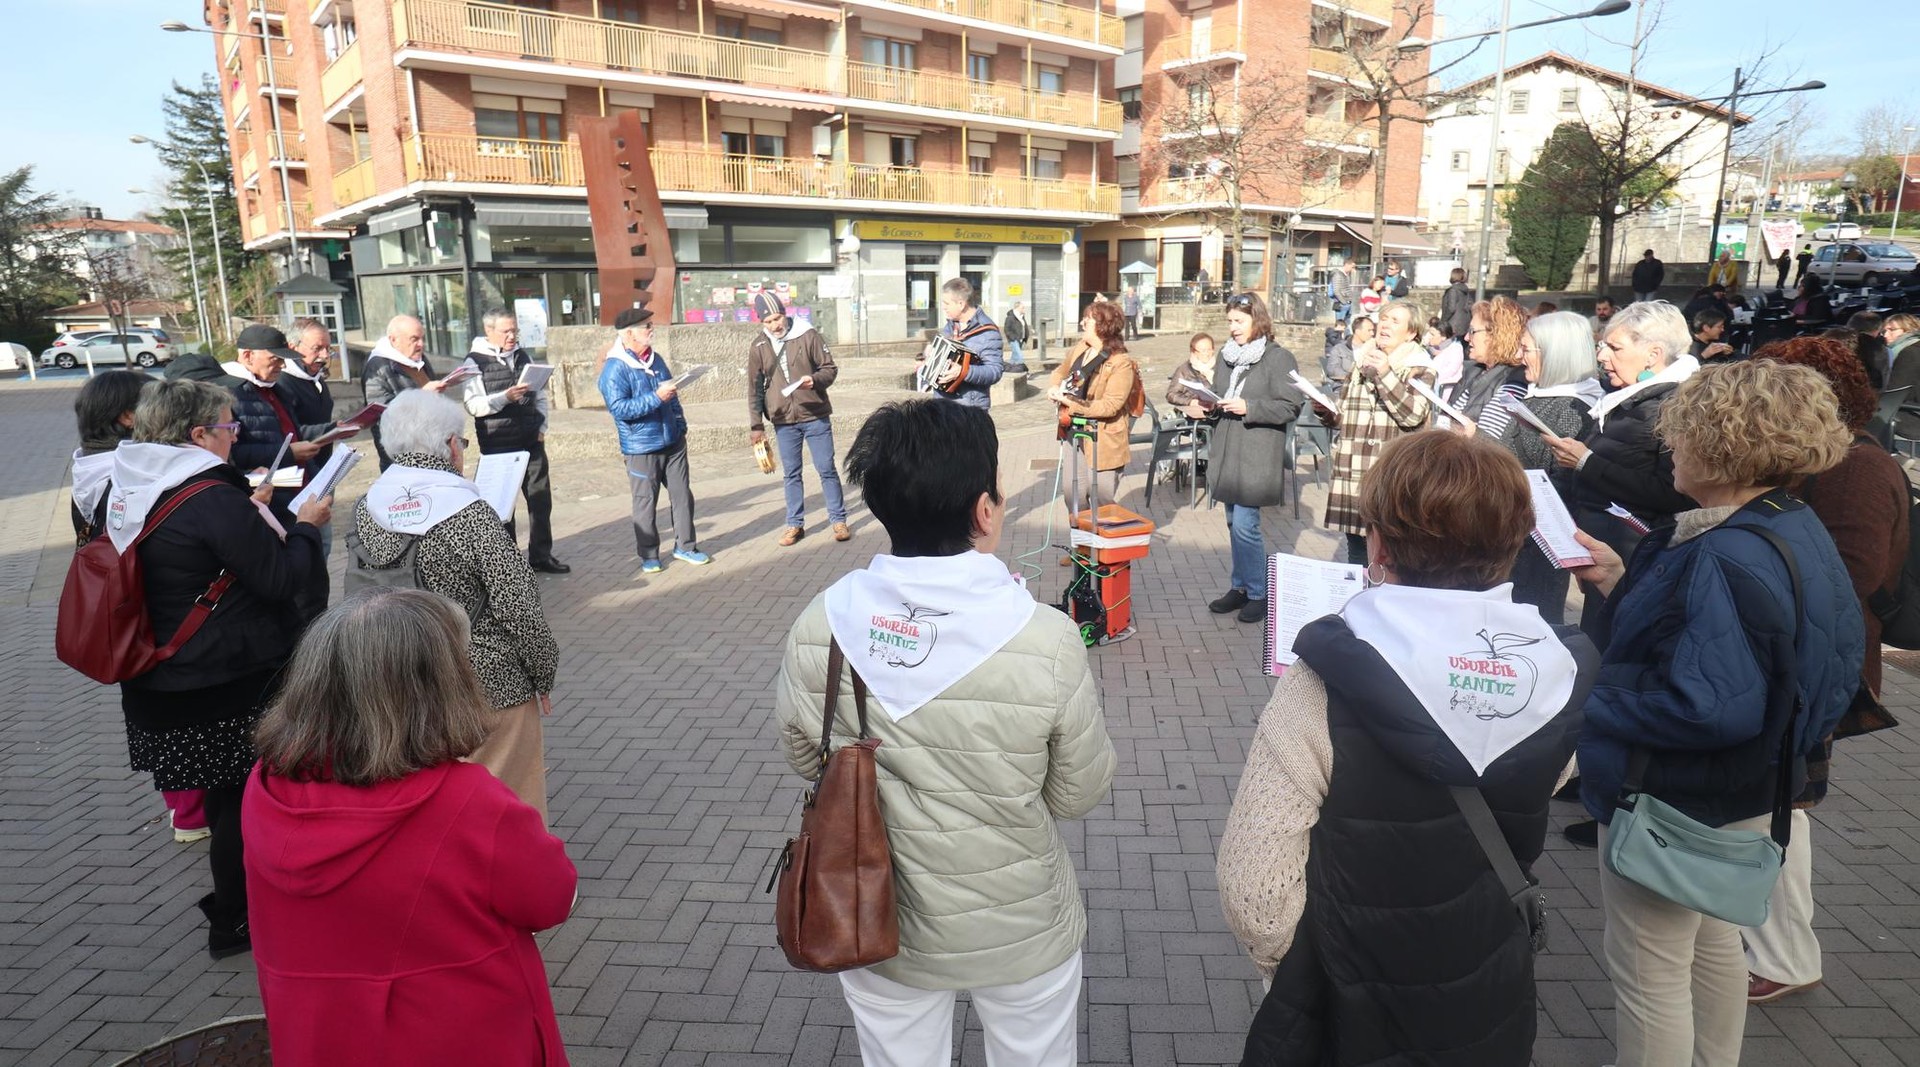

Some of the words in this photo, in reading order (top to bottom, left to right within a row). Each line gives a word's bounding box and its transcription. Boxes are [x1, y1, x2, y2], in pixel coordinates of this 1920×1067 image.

[872, 615, 919, 637] USURBIL
[869, 628, 917, 651] KANTUZ
[1448, 656, 1517, 677] USURBIL
[1448, 673, 1516, 696] KANTUZ
